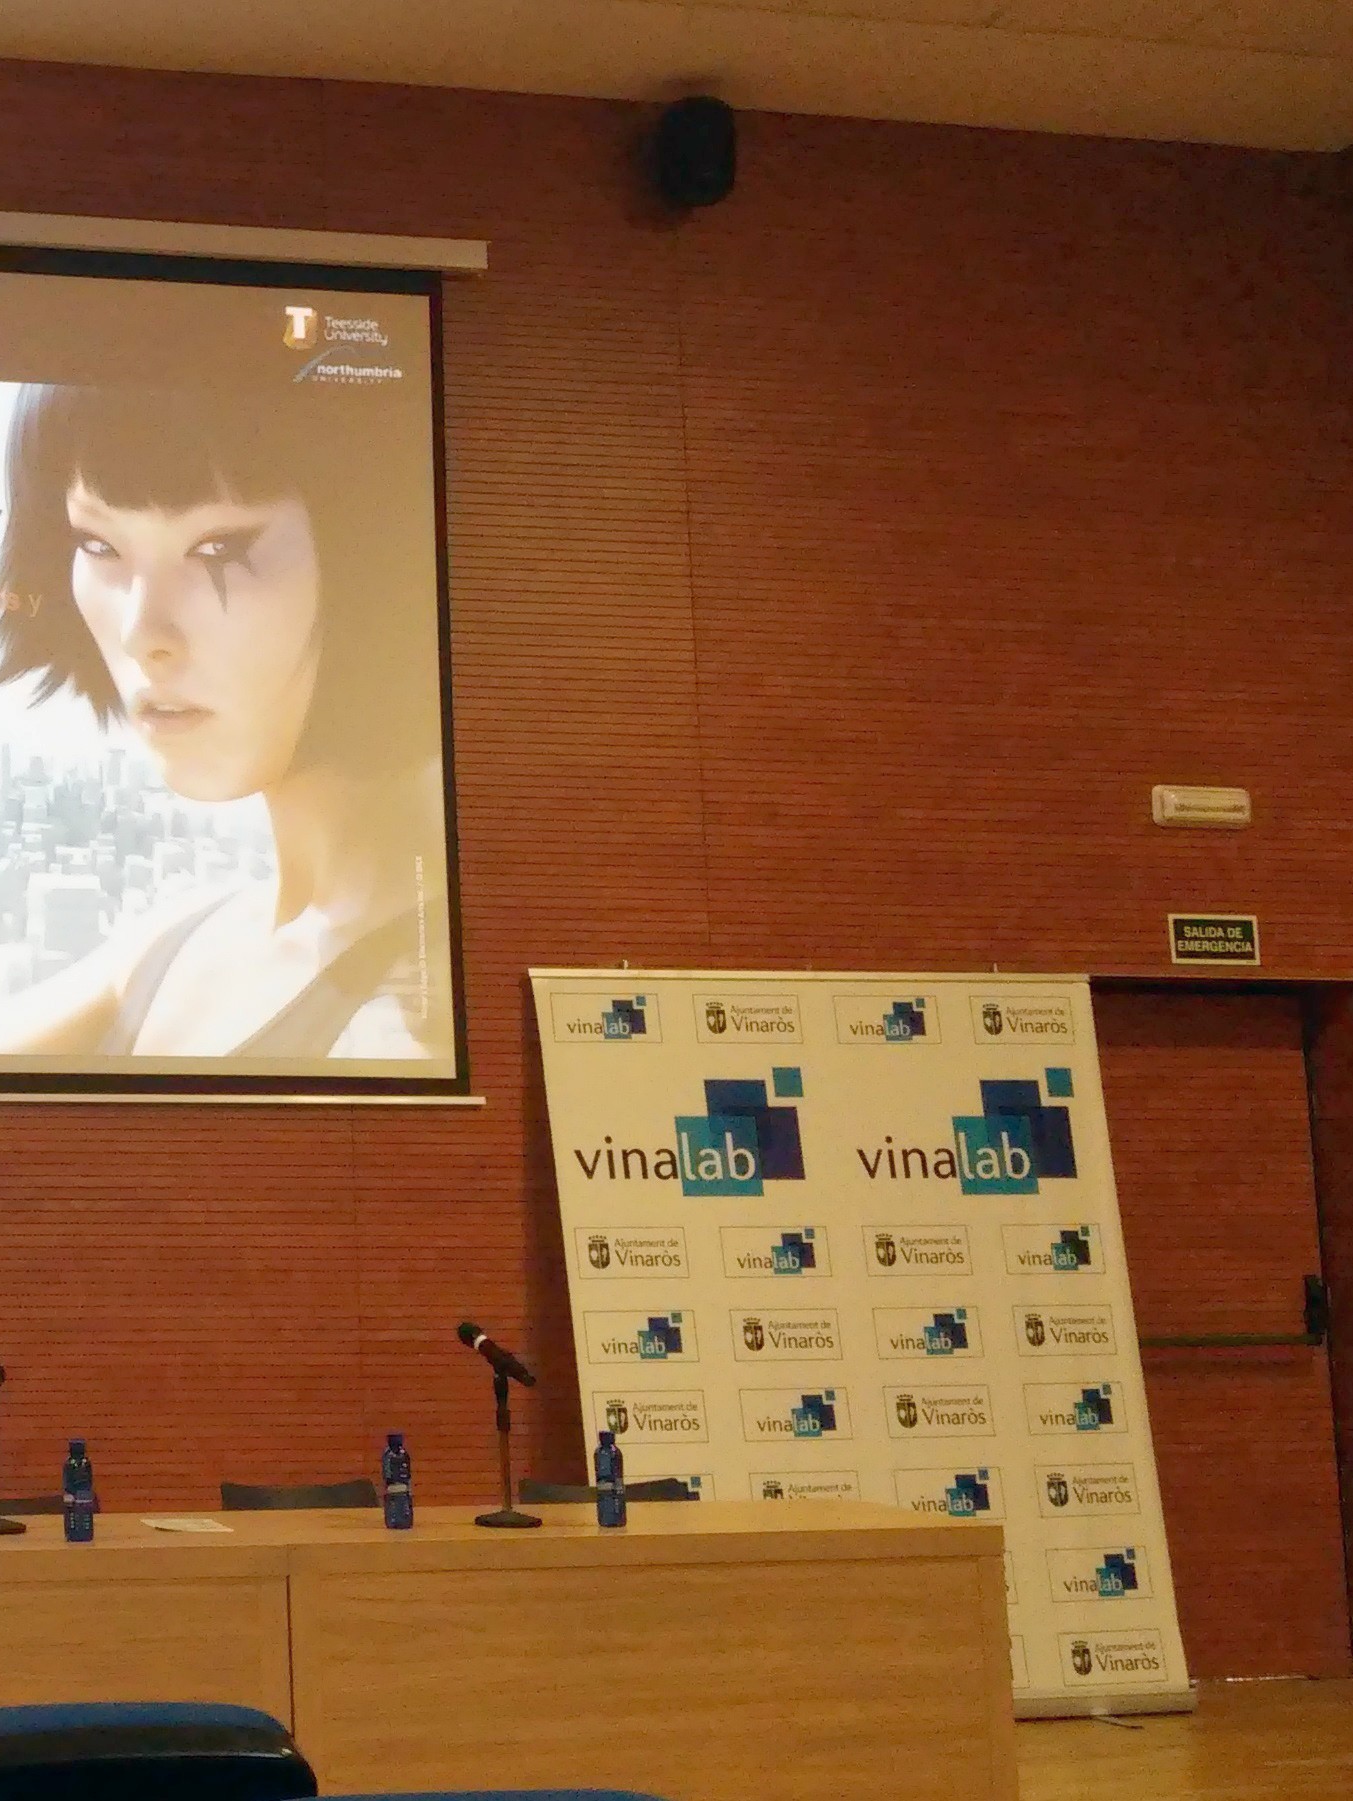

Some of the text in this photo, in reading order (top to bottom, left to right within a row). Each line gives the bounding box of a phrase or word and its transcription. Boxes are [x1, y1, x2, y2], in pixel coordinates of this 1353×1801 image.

[324, 316, 378, 329] Teesside
[324, 330, 388, 346] University
[317, 365, 402, 378] northumbria
[27, 592, 42, 617] y
[1184, 926, 1243, 938] SALIDA DE
[1178, 940, 1252, 952] EMERGENCIA
[730, 1004, 794, 1017] Ajuntament de
[1006, 1005, 1066, 1018] Ajuntament de
[567, 1016, 631, 1036] vinalab
[731, 1013, 796, 1034] Vinaròs
[849, 1017, 911, 1037] vinalab
[1006, 1015, 1067, 1035] Vinaròs
[574, 1132, 757, 1181] vinalab
[856, 1131, 1032, 1180] vinalab
[615, 1238, 679, 1250] Ajuntament de
[899, 1237, 962, 1249] Ajuntament de
[615, 1250, 681, 1267] Vinaròs
[737, 1251, 799, 1269] vinalab
[900, 1248, 965, 1264] Vinaròs
[1018, 1248, 1077, 1266] vinalab
[768, 1320, 831, 1332] Ajuntament de
[768, 1332, 834, 1349] Vinaròs
[890, 1333, 952, 1350] vinalab
[1049, 1327, 1109, 1344] Vinaròs
[601, 1336, 666, 1355] vinalab
[633, 1402, 698, 1413] Ajuntament de
[633, 1413, 700, 1431] Vinaròs
[757, 1413, 821, 1433] vinalab
[922, 1408, 986, 1426] Vinaròs
[1040, 1408, 1098, 1426] vinalab
[788, 1483, 852, 1494] Ajuntament de
[1073, 1486, 1131, 1504] Vinaròs
[912, 1492, 974, 1512] vinalab
[1064, 1575, 1123, 1593] vinalab
[1095, 1653, 1159, 1672] Vinaròs
